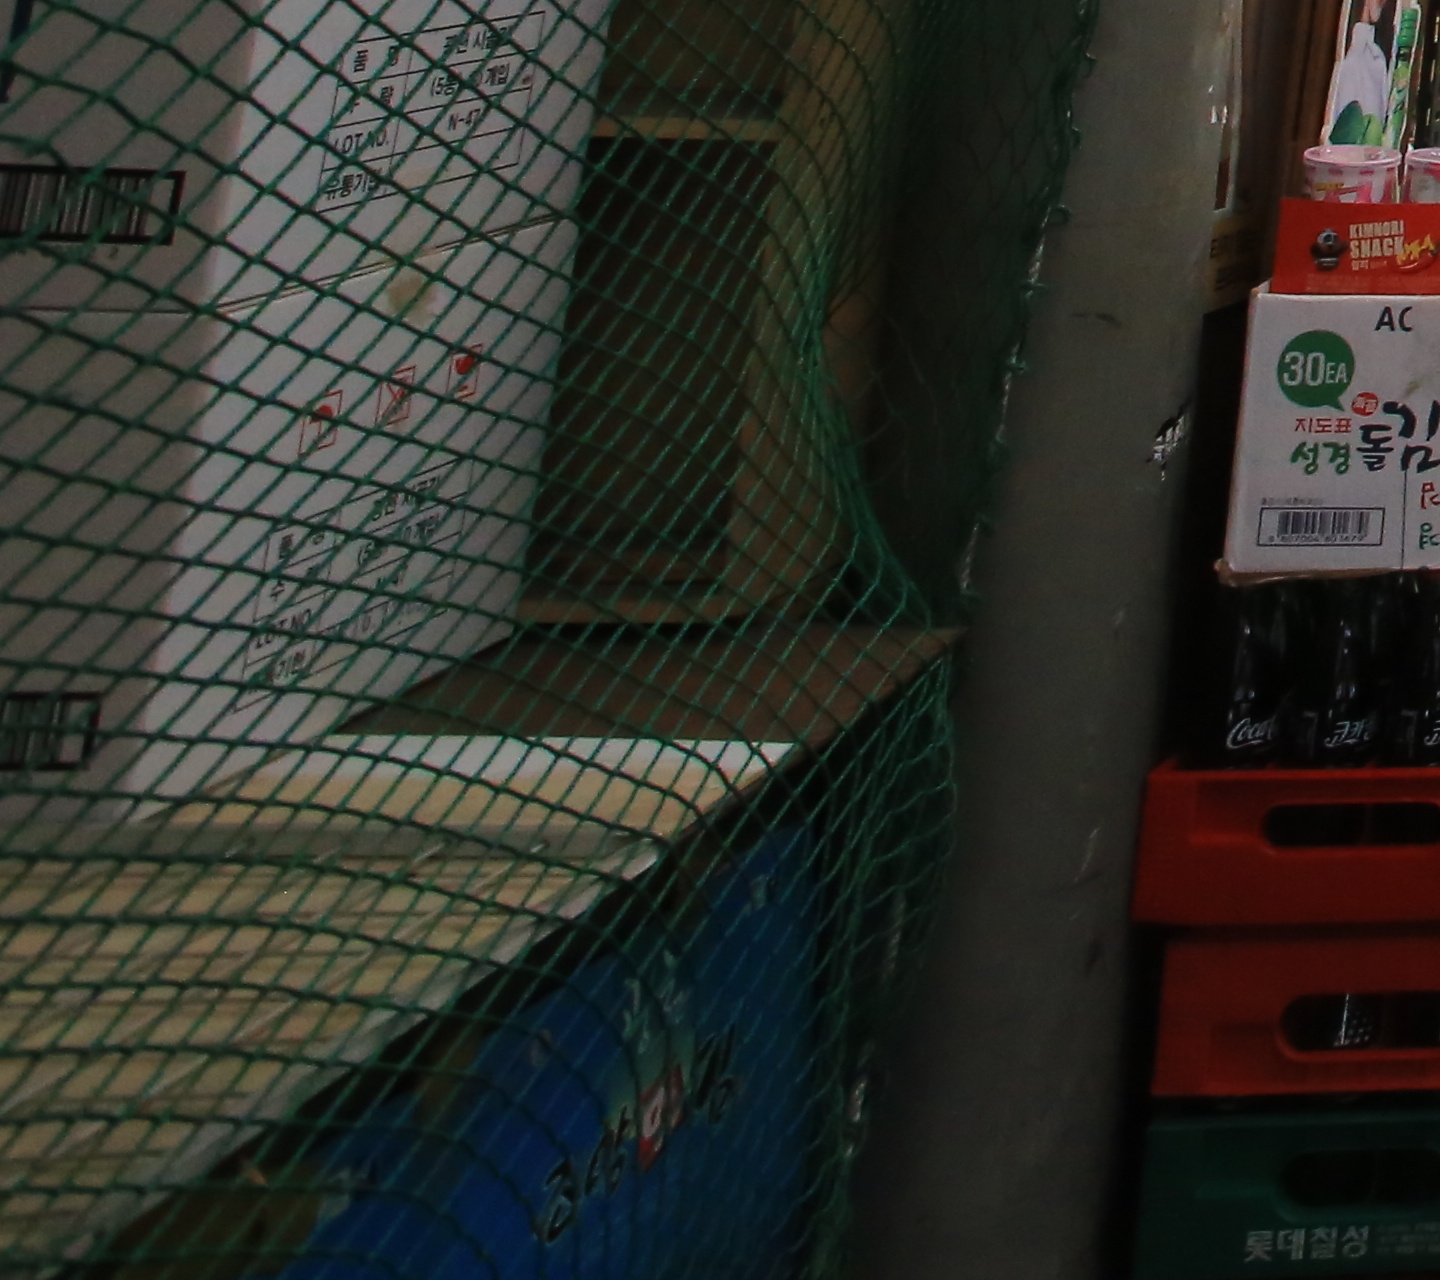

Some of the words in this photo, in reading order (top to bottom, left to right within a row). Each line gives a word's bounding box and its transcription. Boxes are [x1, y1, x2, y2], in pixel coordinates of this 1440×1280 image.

[1349, 220, 1405, 239] KIMNORI
[1349, 237, 1407, 258] SNACK
[1374, 306, 1413, 333] AC
[1282, 351, 1350, 388] 30EA
[1295, 418, 1353, 435] 지도표
[1290, 441, 1352, 476] 성경
[1243, 1225, 1371, 1262] 롯데칠성
